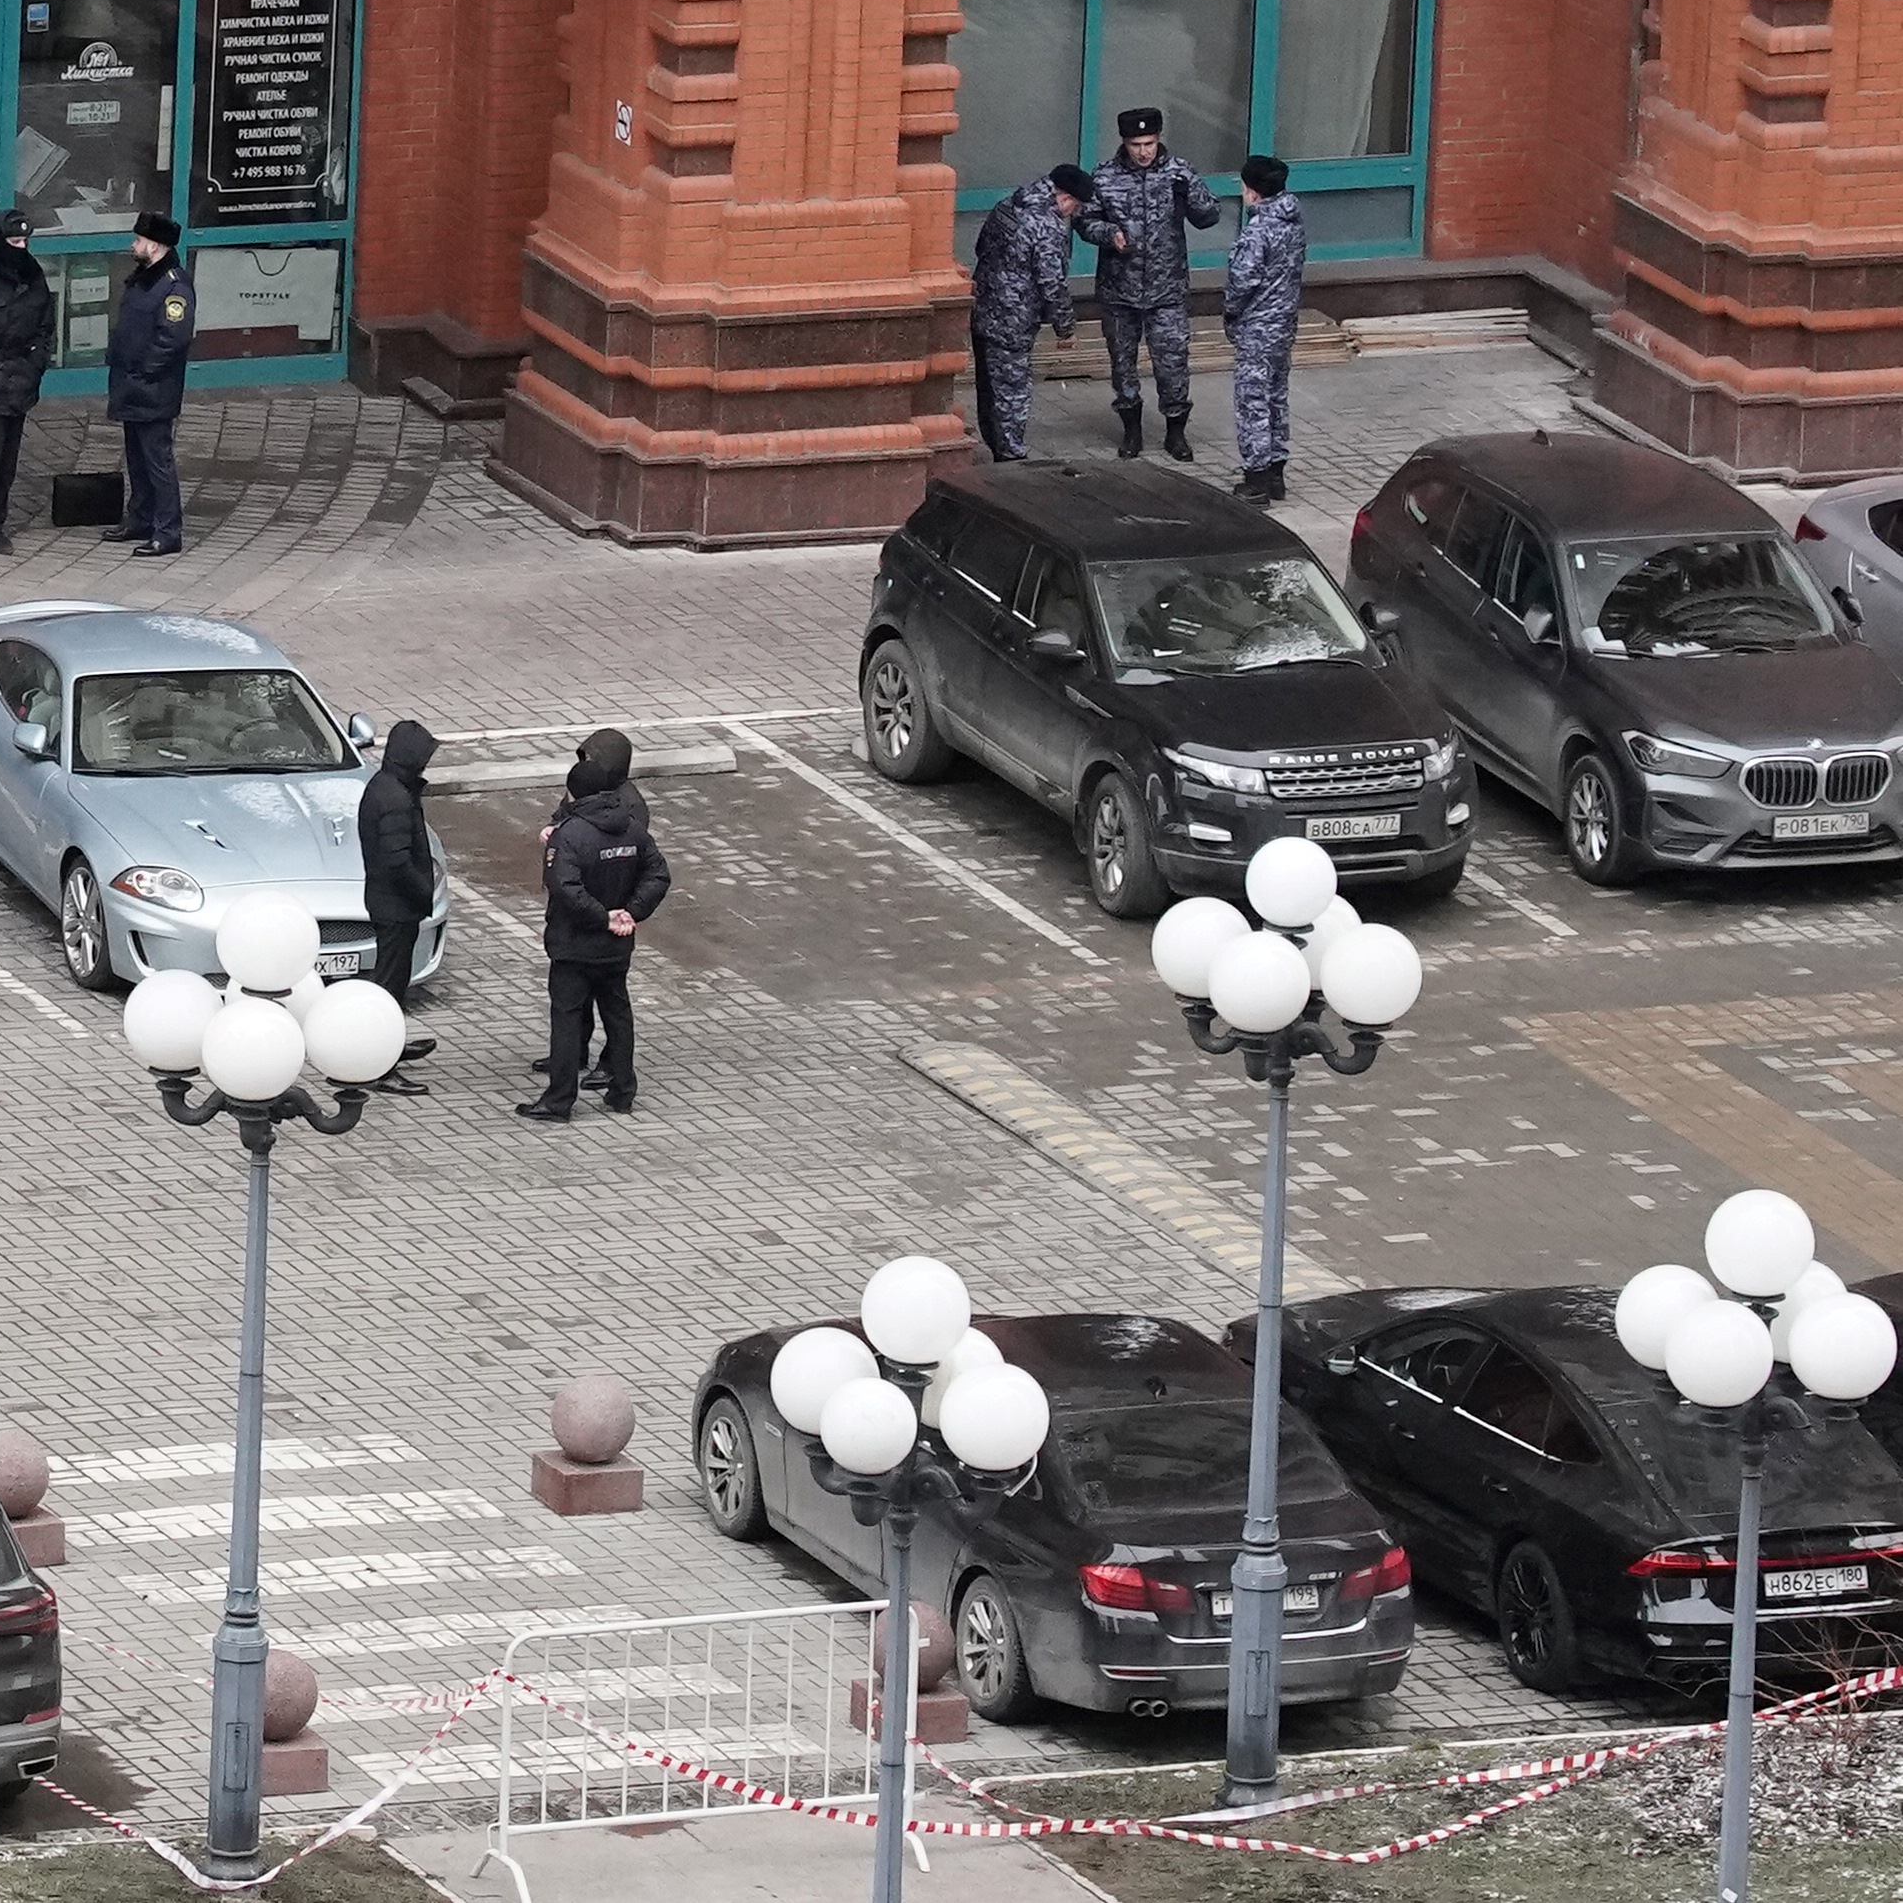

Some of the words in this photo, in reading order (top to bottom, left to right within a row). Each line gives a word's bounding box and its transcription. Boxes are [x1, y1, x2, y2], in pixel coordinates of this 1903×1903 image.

[219, 17, 270, 30] ХИМЧИСТКА
[271, 15, 295, 27] МЕХА
[223, 35, 266, 48] ХРАНЕНИЕ
[267, 34, 291, 46] МЕХА
[224, 54, 258, 67] РУЧНАЯ
[259, 52, 291, 64] ЧИСТКА
[61, 65, 135, 81] Химчистка
[235, 72, 270, 84] РЕМОНТ
[271, 70, 309, 84] ОДЕЖДЫ
[256, 89, 287, 102] АТЕЛЬЕ
[222, 110, 256, 122] РУЧНАЯ
[257, 108, 289, 120] ЧИСТКА
[290, 106, 319, 119] ОБУВИ
[238, 127, 272, 140] РЕМОНТ
[273, 126, 302, 138] ОБУВИ
[235, 146, 268, 158] ЧИСТКА
[269, 144, 302, 156] КОВРОВ
[247, 166, 264, 178] 495
[1268, 754, 1339, 765] RANGE
[1351, 746, 1416, 760] ROVER
